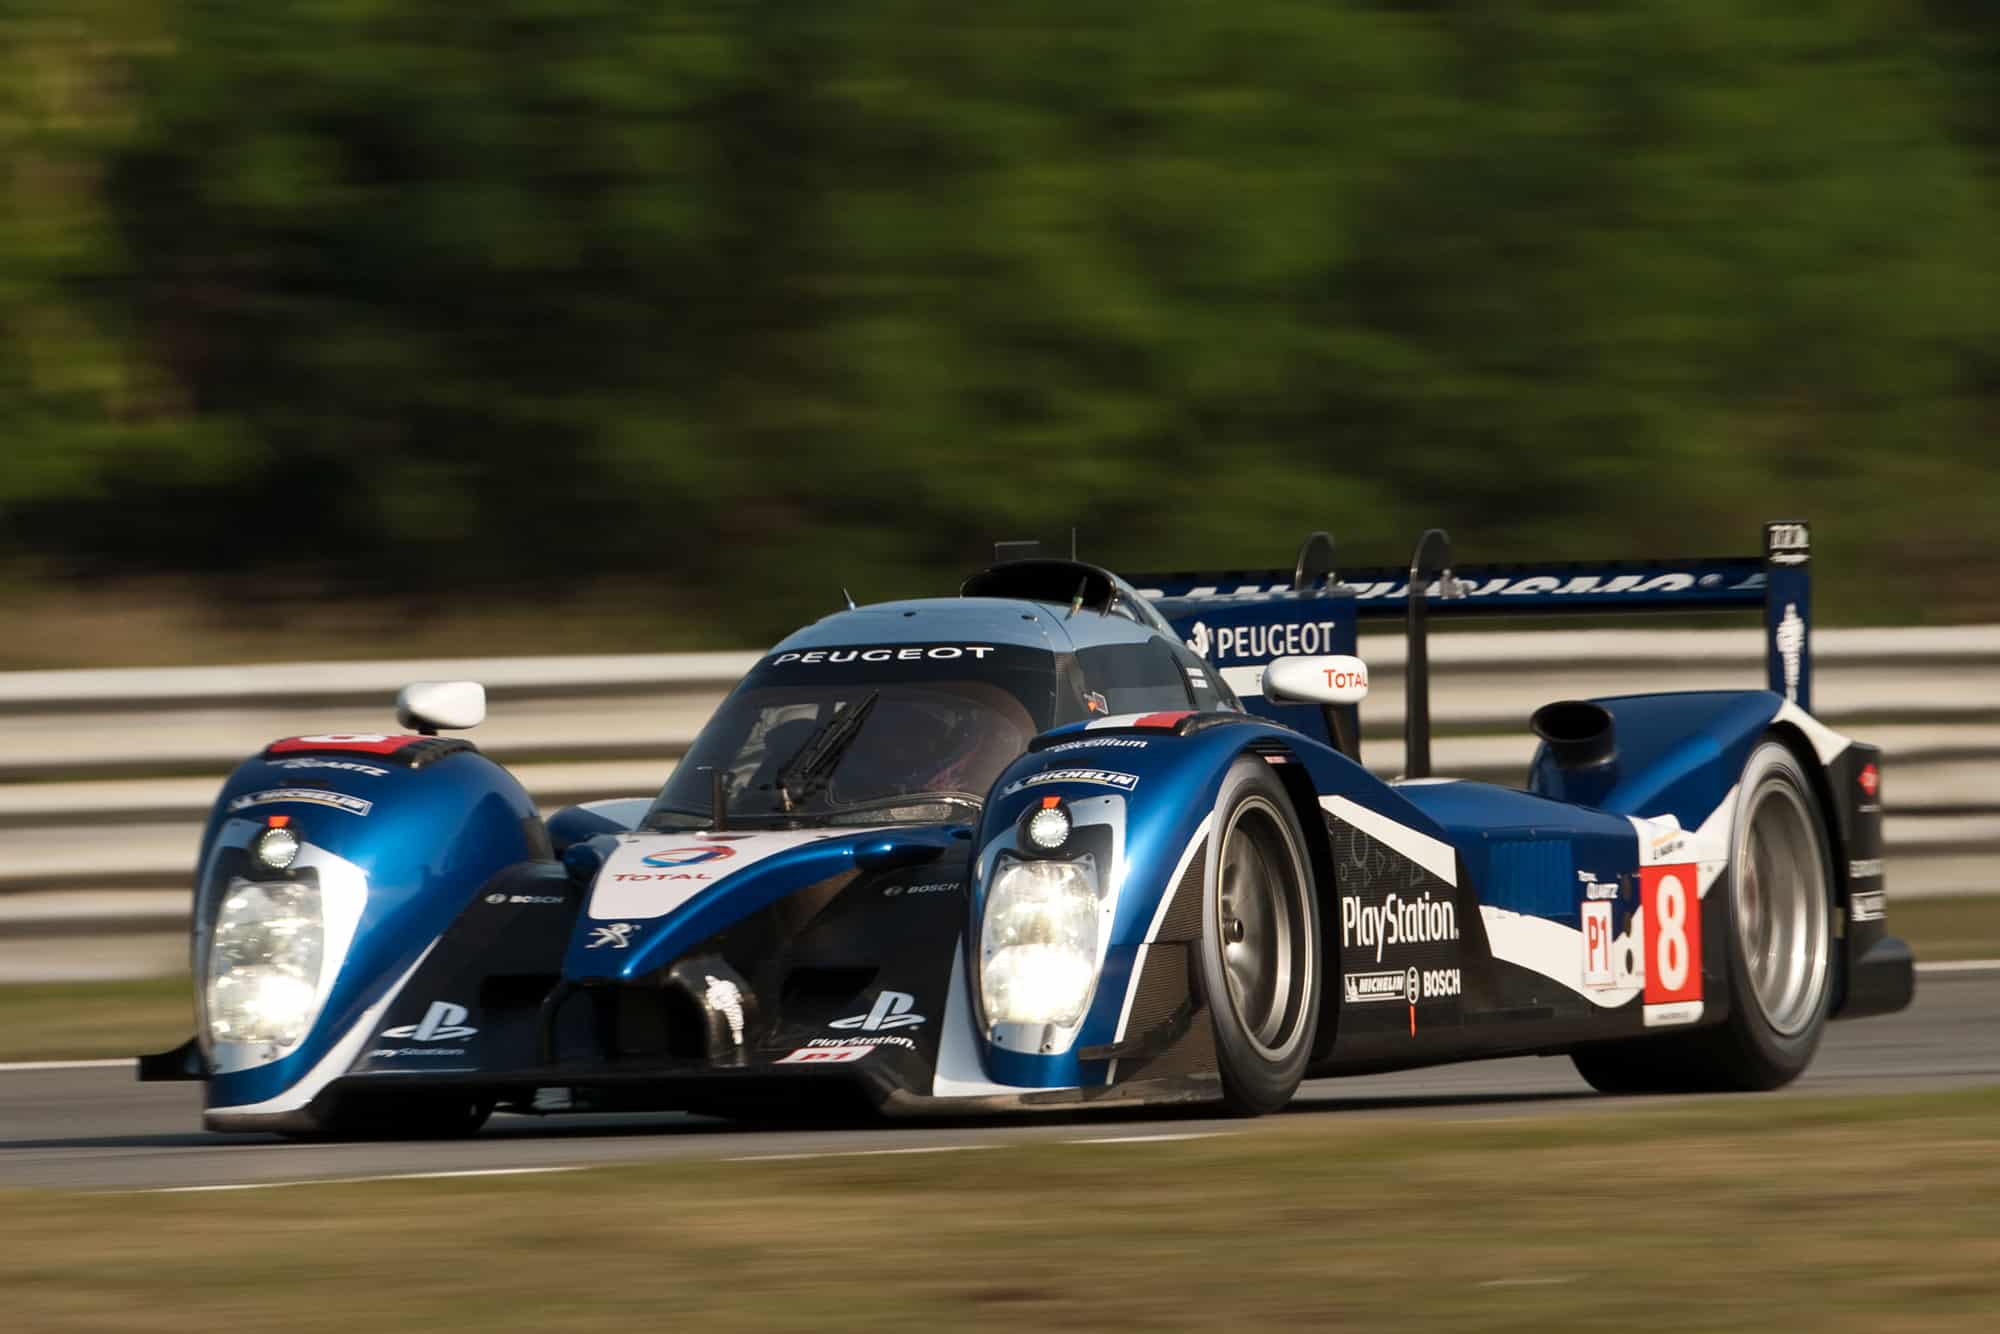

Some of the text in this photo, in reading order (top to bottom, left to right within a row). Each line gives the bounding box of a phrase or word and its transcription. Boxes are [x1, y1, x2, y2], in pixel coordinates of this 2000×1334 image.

[1217, 622, 1335, 657] PEUGEOT
[773, 647, 994, 666] PEUGEOT
[613, 873, 713, 882] TOTAL
[907, 883, 960, 894] BOSCH
[1342, 892, 1456, 963] PlayStation
[1657, 874, 1689, 991] 8
[1588, 916, 1608, 972] P1
[1359, 975, 1404, 993] MICHELIN
[1423, 968, 1461, 997] BOSCH
